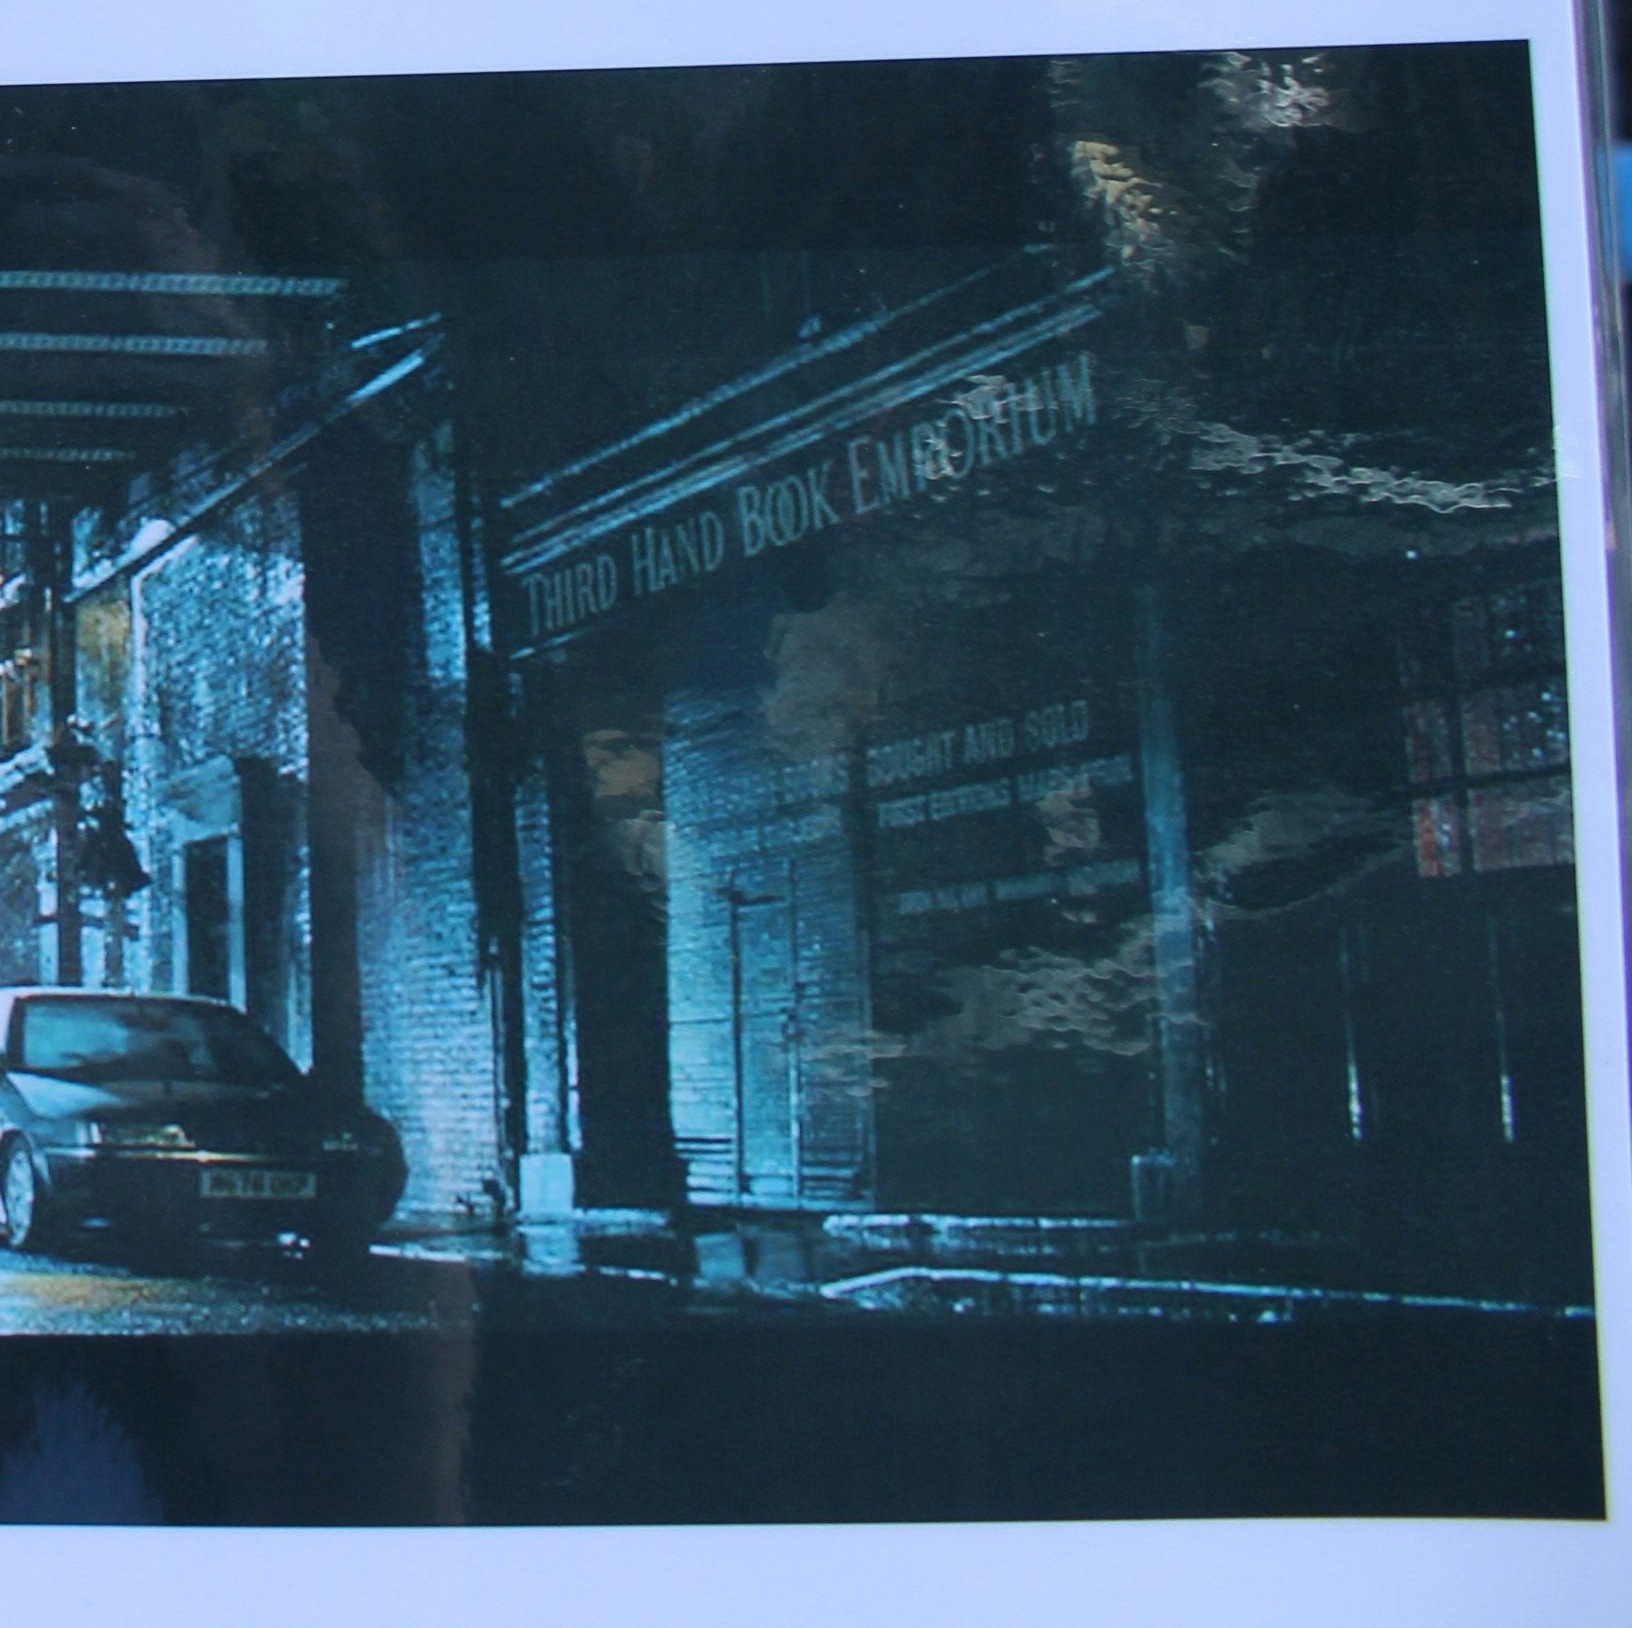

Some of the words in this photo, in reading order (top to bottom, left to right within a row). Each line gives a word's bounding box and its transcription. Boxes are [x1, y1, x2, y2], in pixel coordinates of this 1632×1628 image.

[520, 553, 618, 636] THIRD
[630, 510, 725, 597] HAND
[737, 458, 840, 557] BOOK
[848, 349, 1098, 515] EMPORIUM
[963, 716, 1015, 765] AND
[1023, 698, 1089, 752] SOLD
